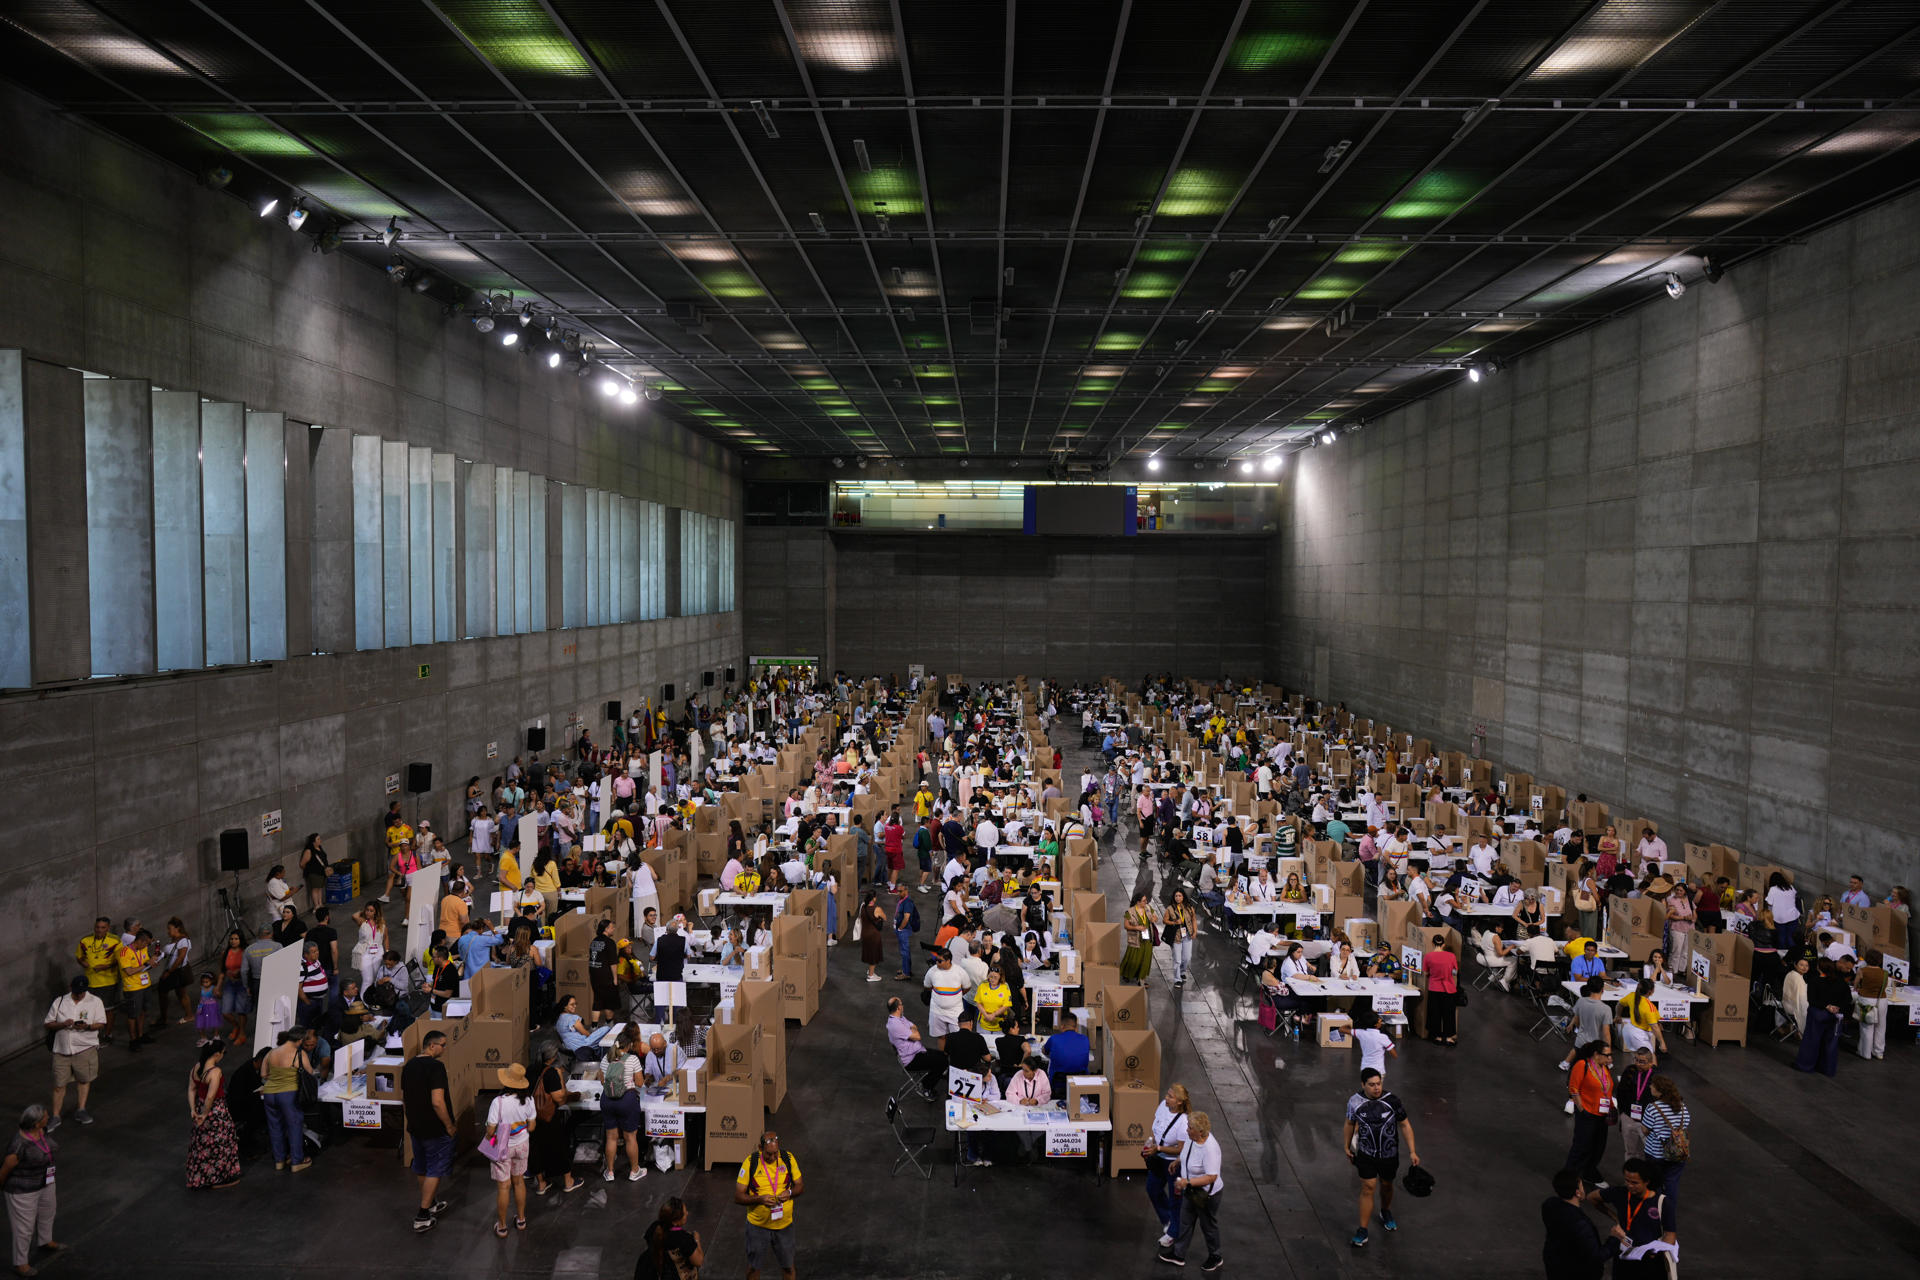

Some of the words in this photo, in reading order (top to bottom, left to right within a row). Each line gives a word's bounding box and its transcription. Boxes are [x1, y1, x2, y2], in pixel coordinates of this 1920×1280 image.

[263, 817, 281, 828] SALIDA
[1196, 831, 1208, 841] 58
[1463, 884, 1475, 896] 47
[1736, 920, 1748, 934] 42
[1404, 954, 1417, 970] 34
[1693, 960, 1705, 977] 35
[1886, 963, 1903, 980] 36
[954, 1079, 976, 1098] 27
